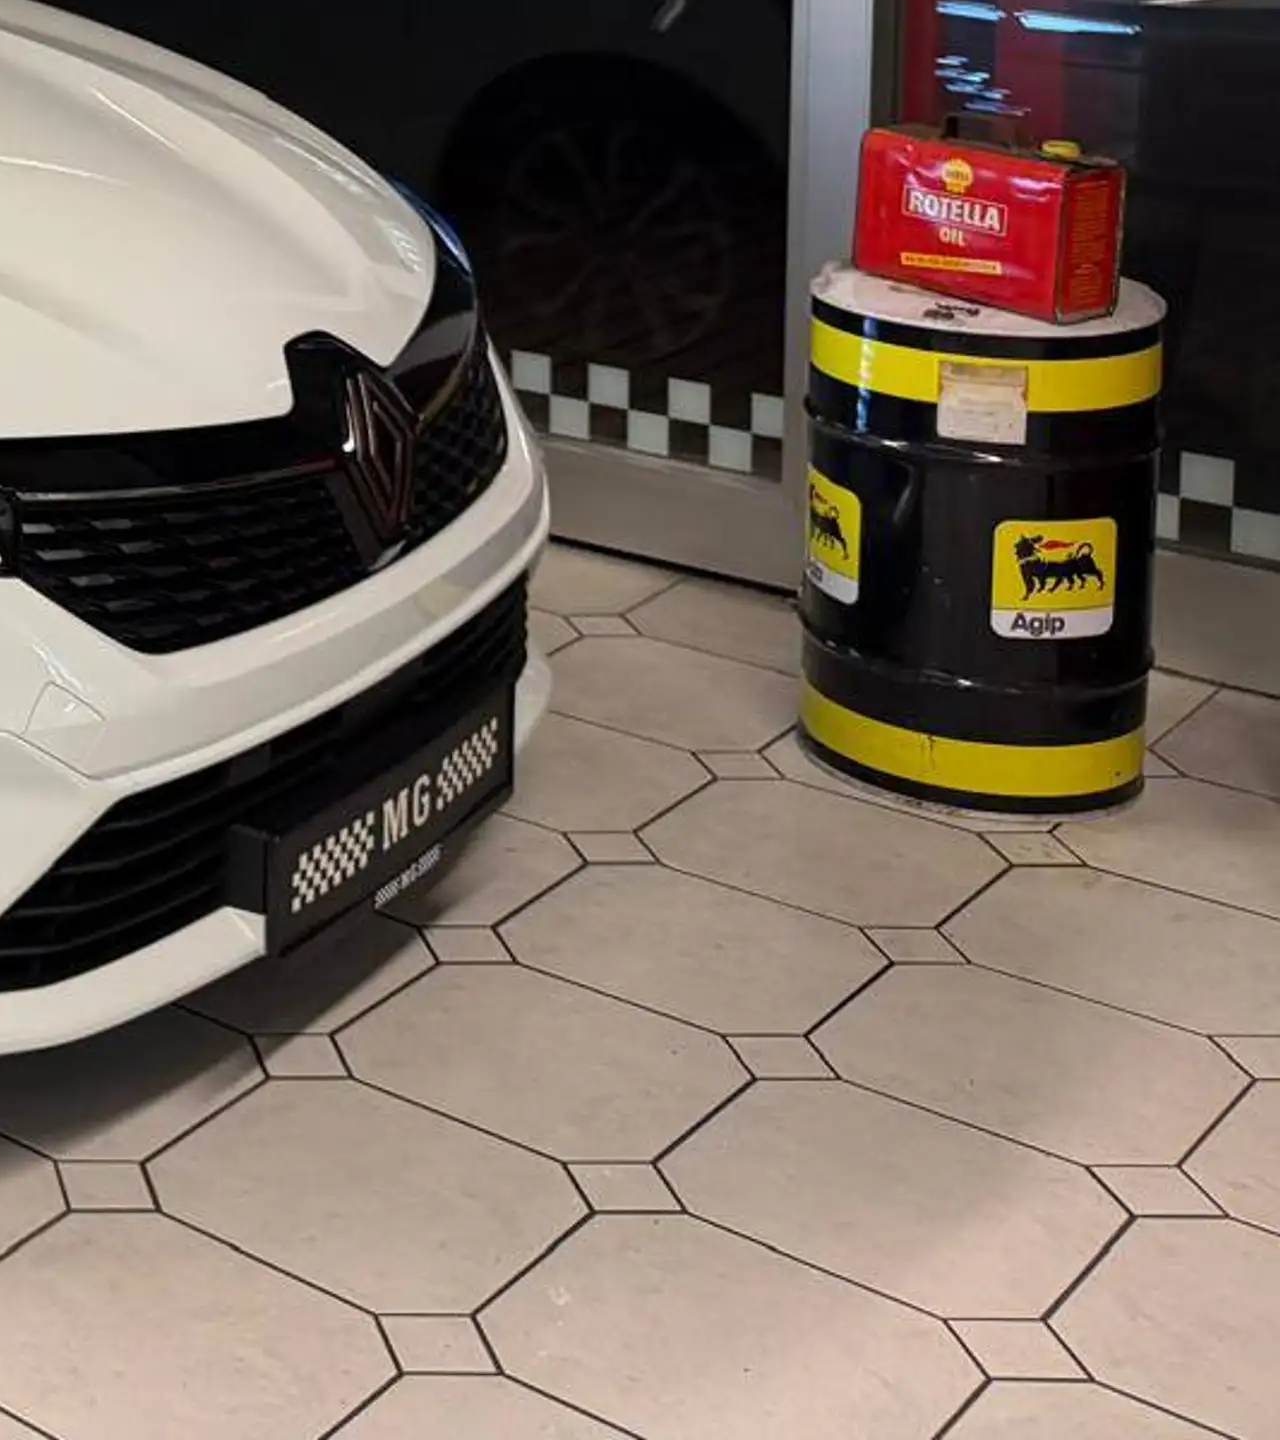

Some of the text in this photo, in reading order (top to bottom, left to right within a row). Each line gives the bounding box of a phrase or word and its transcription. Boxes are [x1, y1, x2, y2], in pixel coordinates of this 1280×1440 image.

[908, 190, 1001, 231] ROTELLA
[939, 227, 967, 247] OIL
[1011, 611, 1065, 637] Agip
[382, 773, 430, 852] MG
